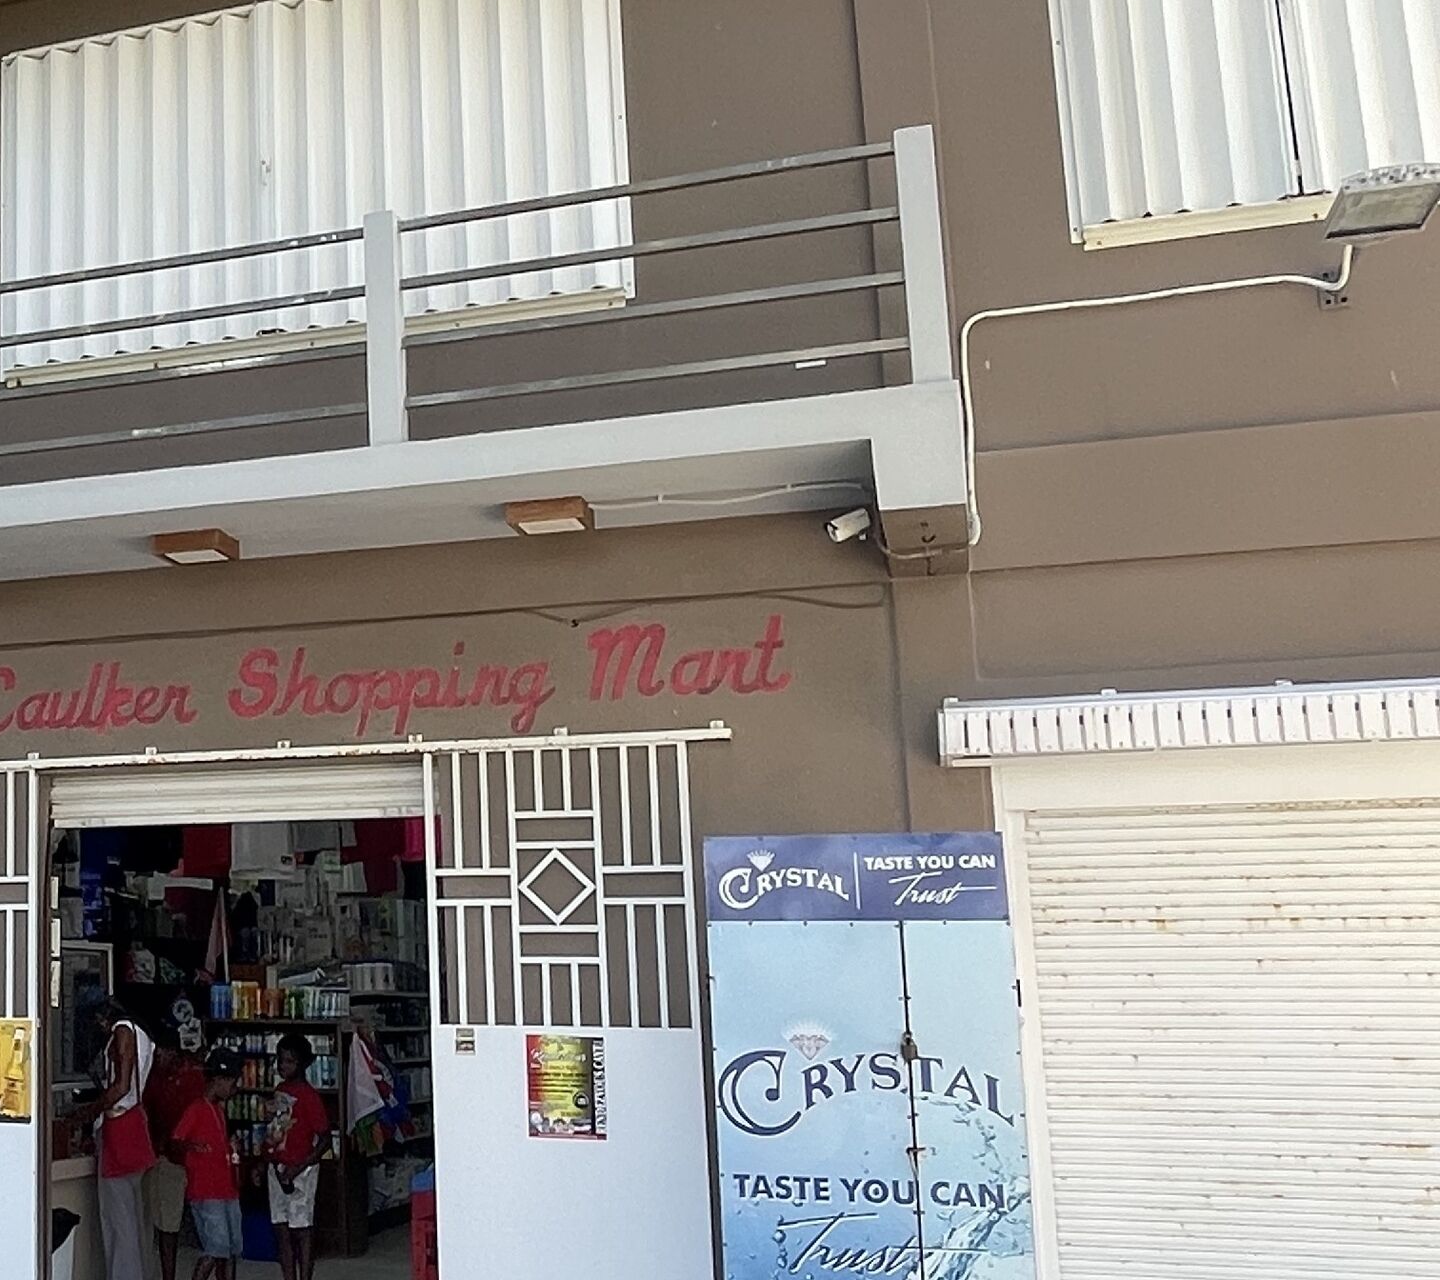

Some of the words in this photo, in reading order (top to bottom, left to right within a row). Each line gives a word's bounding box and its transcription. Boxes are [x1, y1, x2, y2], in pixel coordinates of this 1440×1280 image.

[227, 642, 552, 737] Shopping
[587, 614, 792, 704] Mart
[863, 855, 914, 871] TASTE
[916, 854, 955, 871] YOU
[958, 854, 997, 869] CAN
[718, 867, 850, 910] CRYSTAL
[888, 871, 997, 906] Trust
[718, 1049, 1015, 1136] CRYSTAL
[733, 1173, 831, 1202] TASTE
[840, 1178, 917, 1206] YOU
[930, 1181, 1008, 1209] CAN
[777, 1211, 989, 1275] Trust
